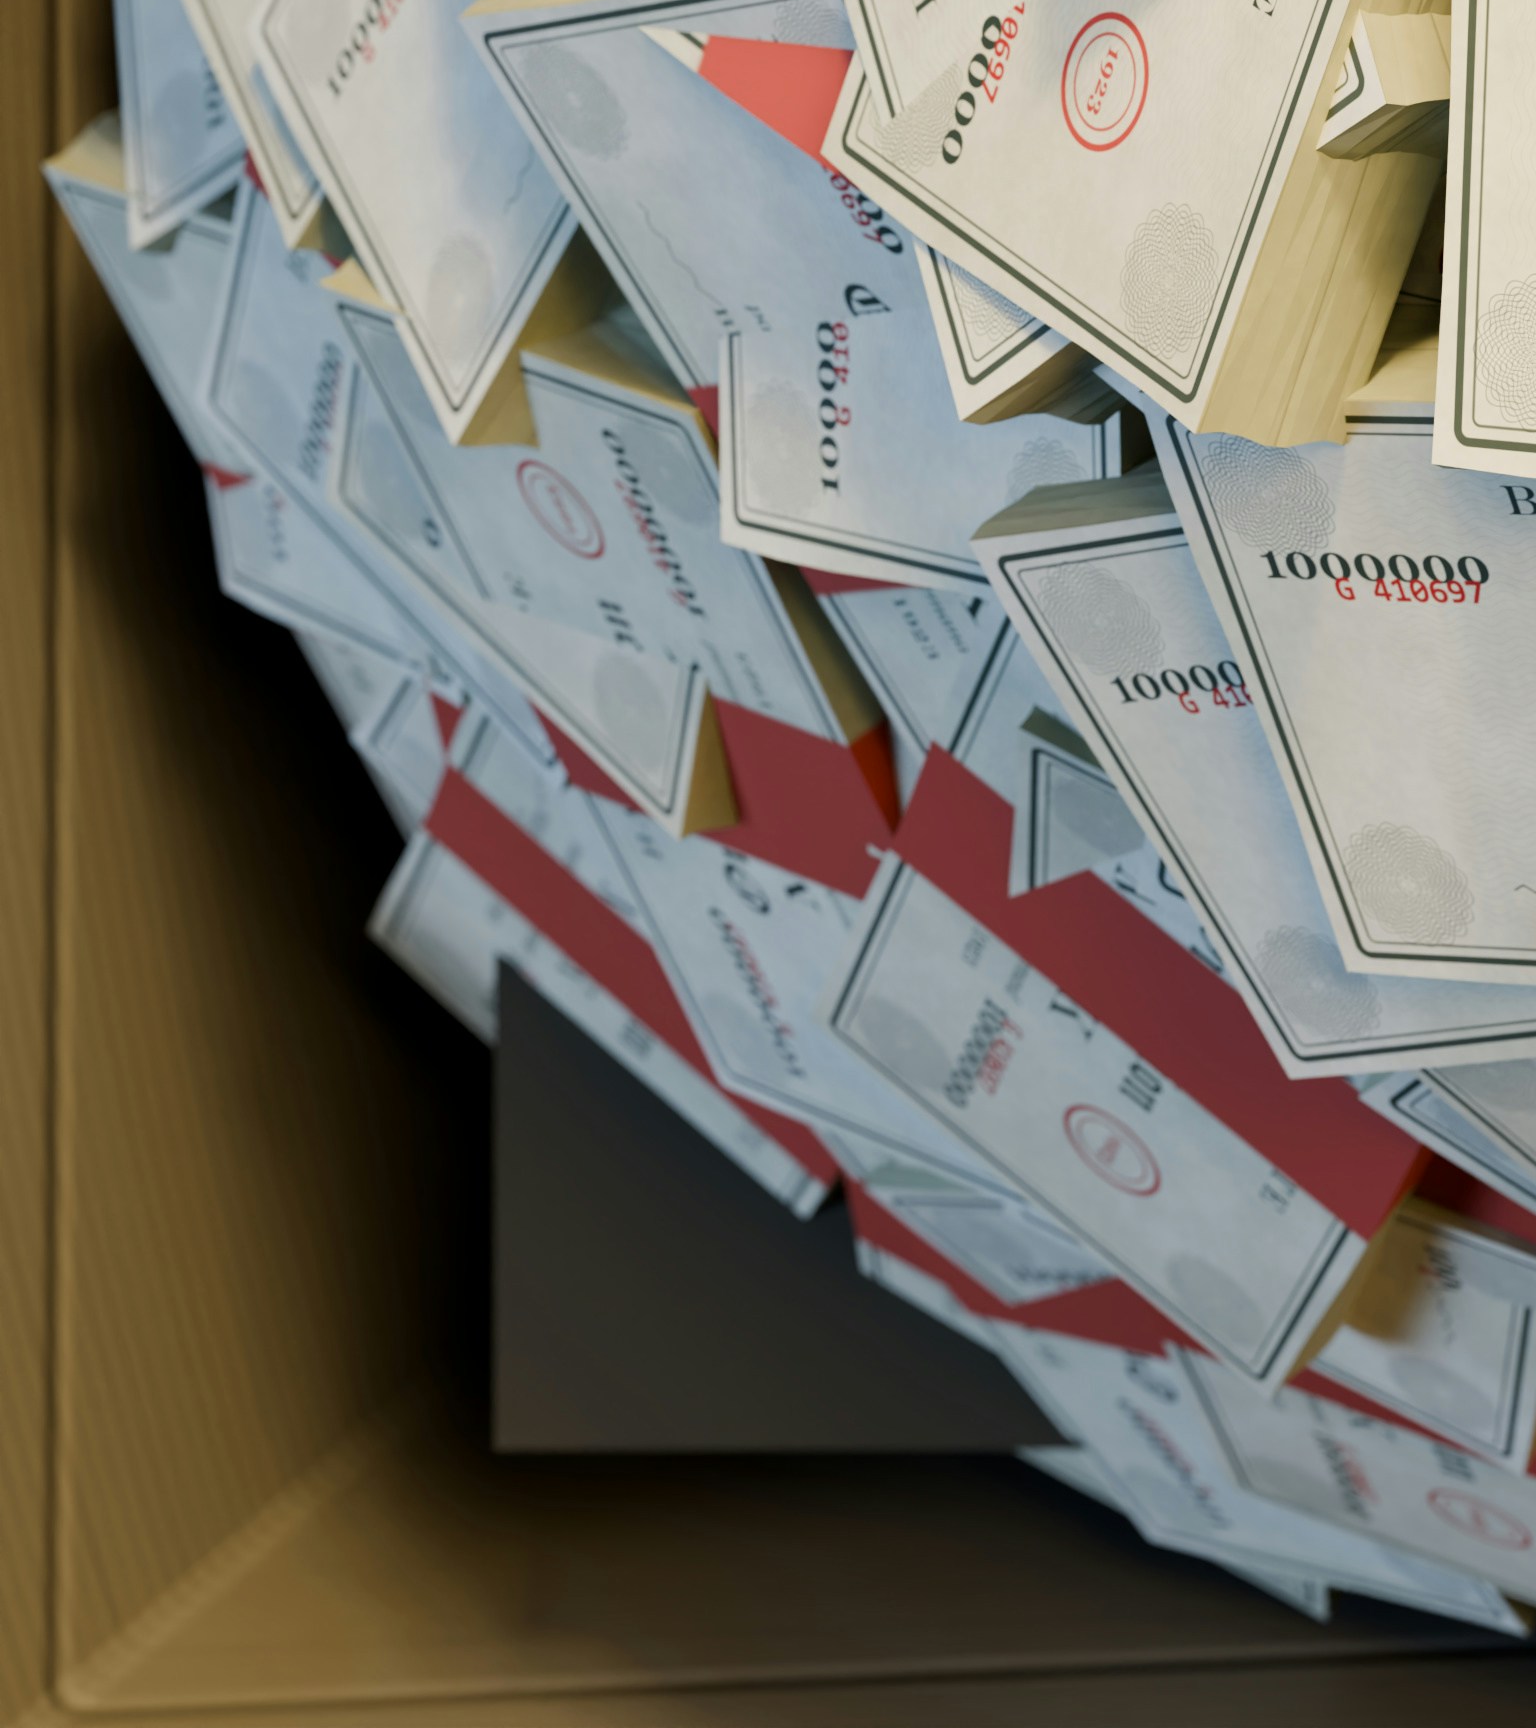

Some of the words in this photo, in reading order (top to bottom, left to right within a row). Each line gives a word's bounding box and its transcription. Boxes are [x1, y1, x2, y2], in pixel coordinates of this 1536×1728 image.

[1086, 48, 1120, 116] 1923
[1260, 549, 1491, 586] 1000000
[1334, 575, 1357, 602] G
[1373, 576, 1482, 605] 410697
